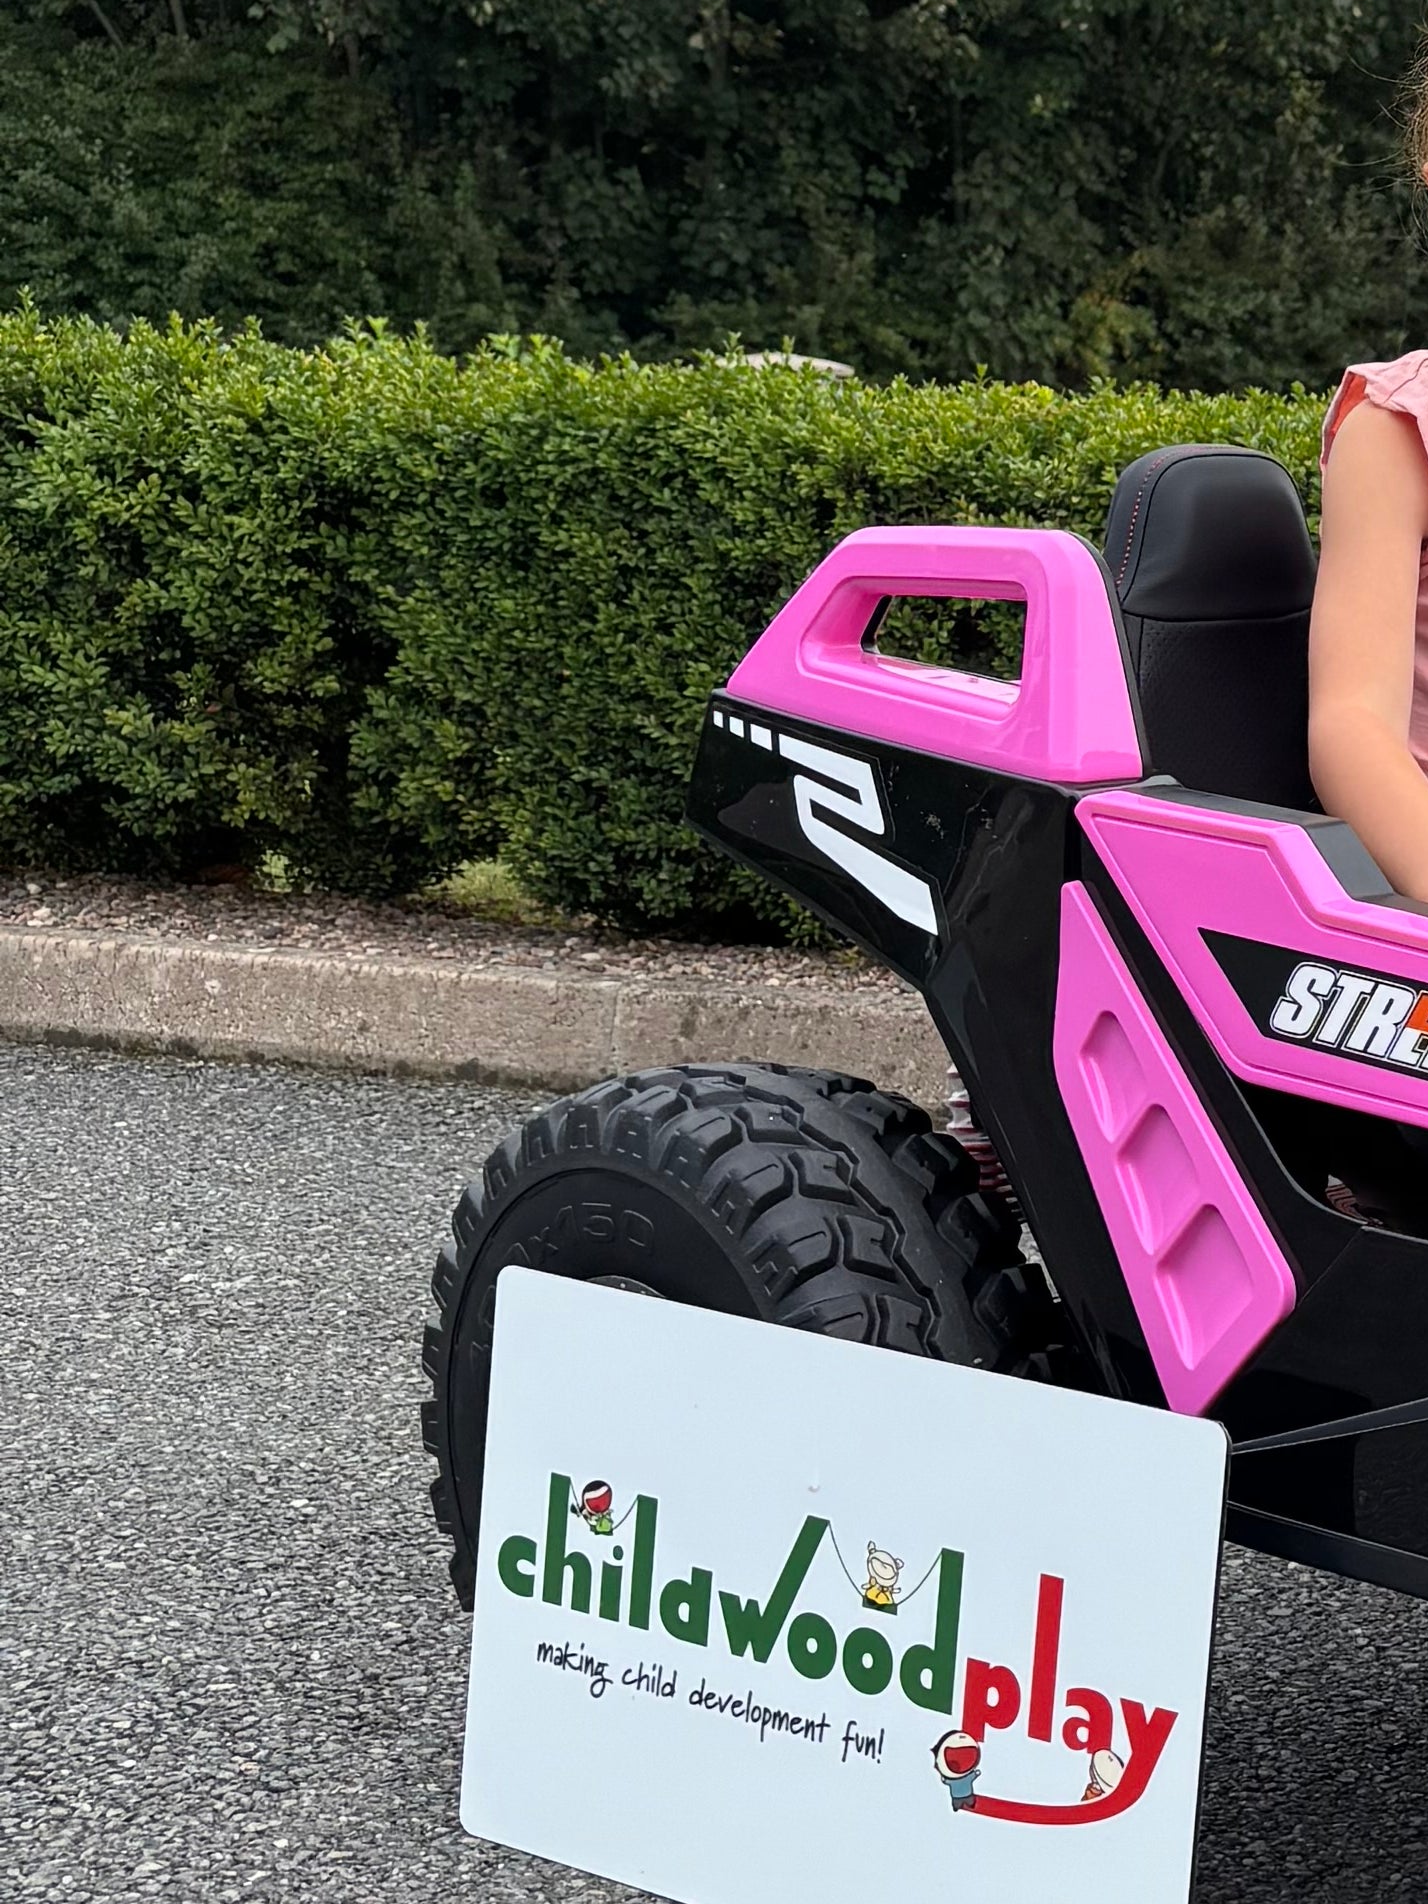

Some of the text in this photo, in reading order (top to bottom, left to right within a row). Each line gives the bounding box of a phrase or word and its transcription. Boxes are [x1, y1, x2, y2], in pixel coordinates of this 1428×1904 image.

[537, 1642, 885, 1764] making child development fun!
